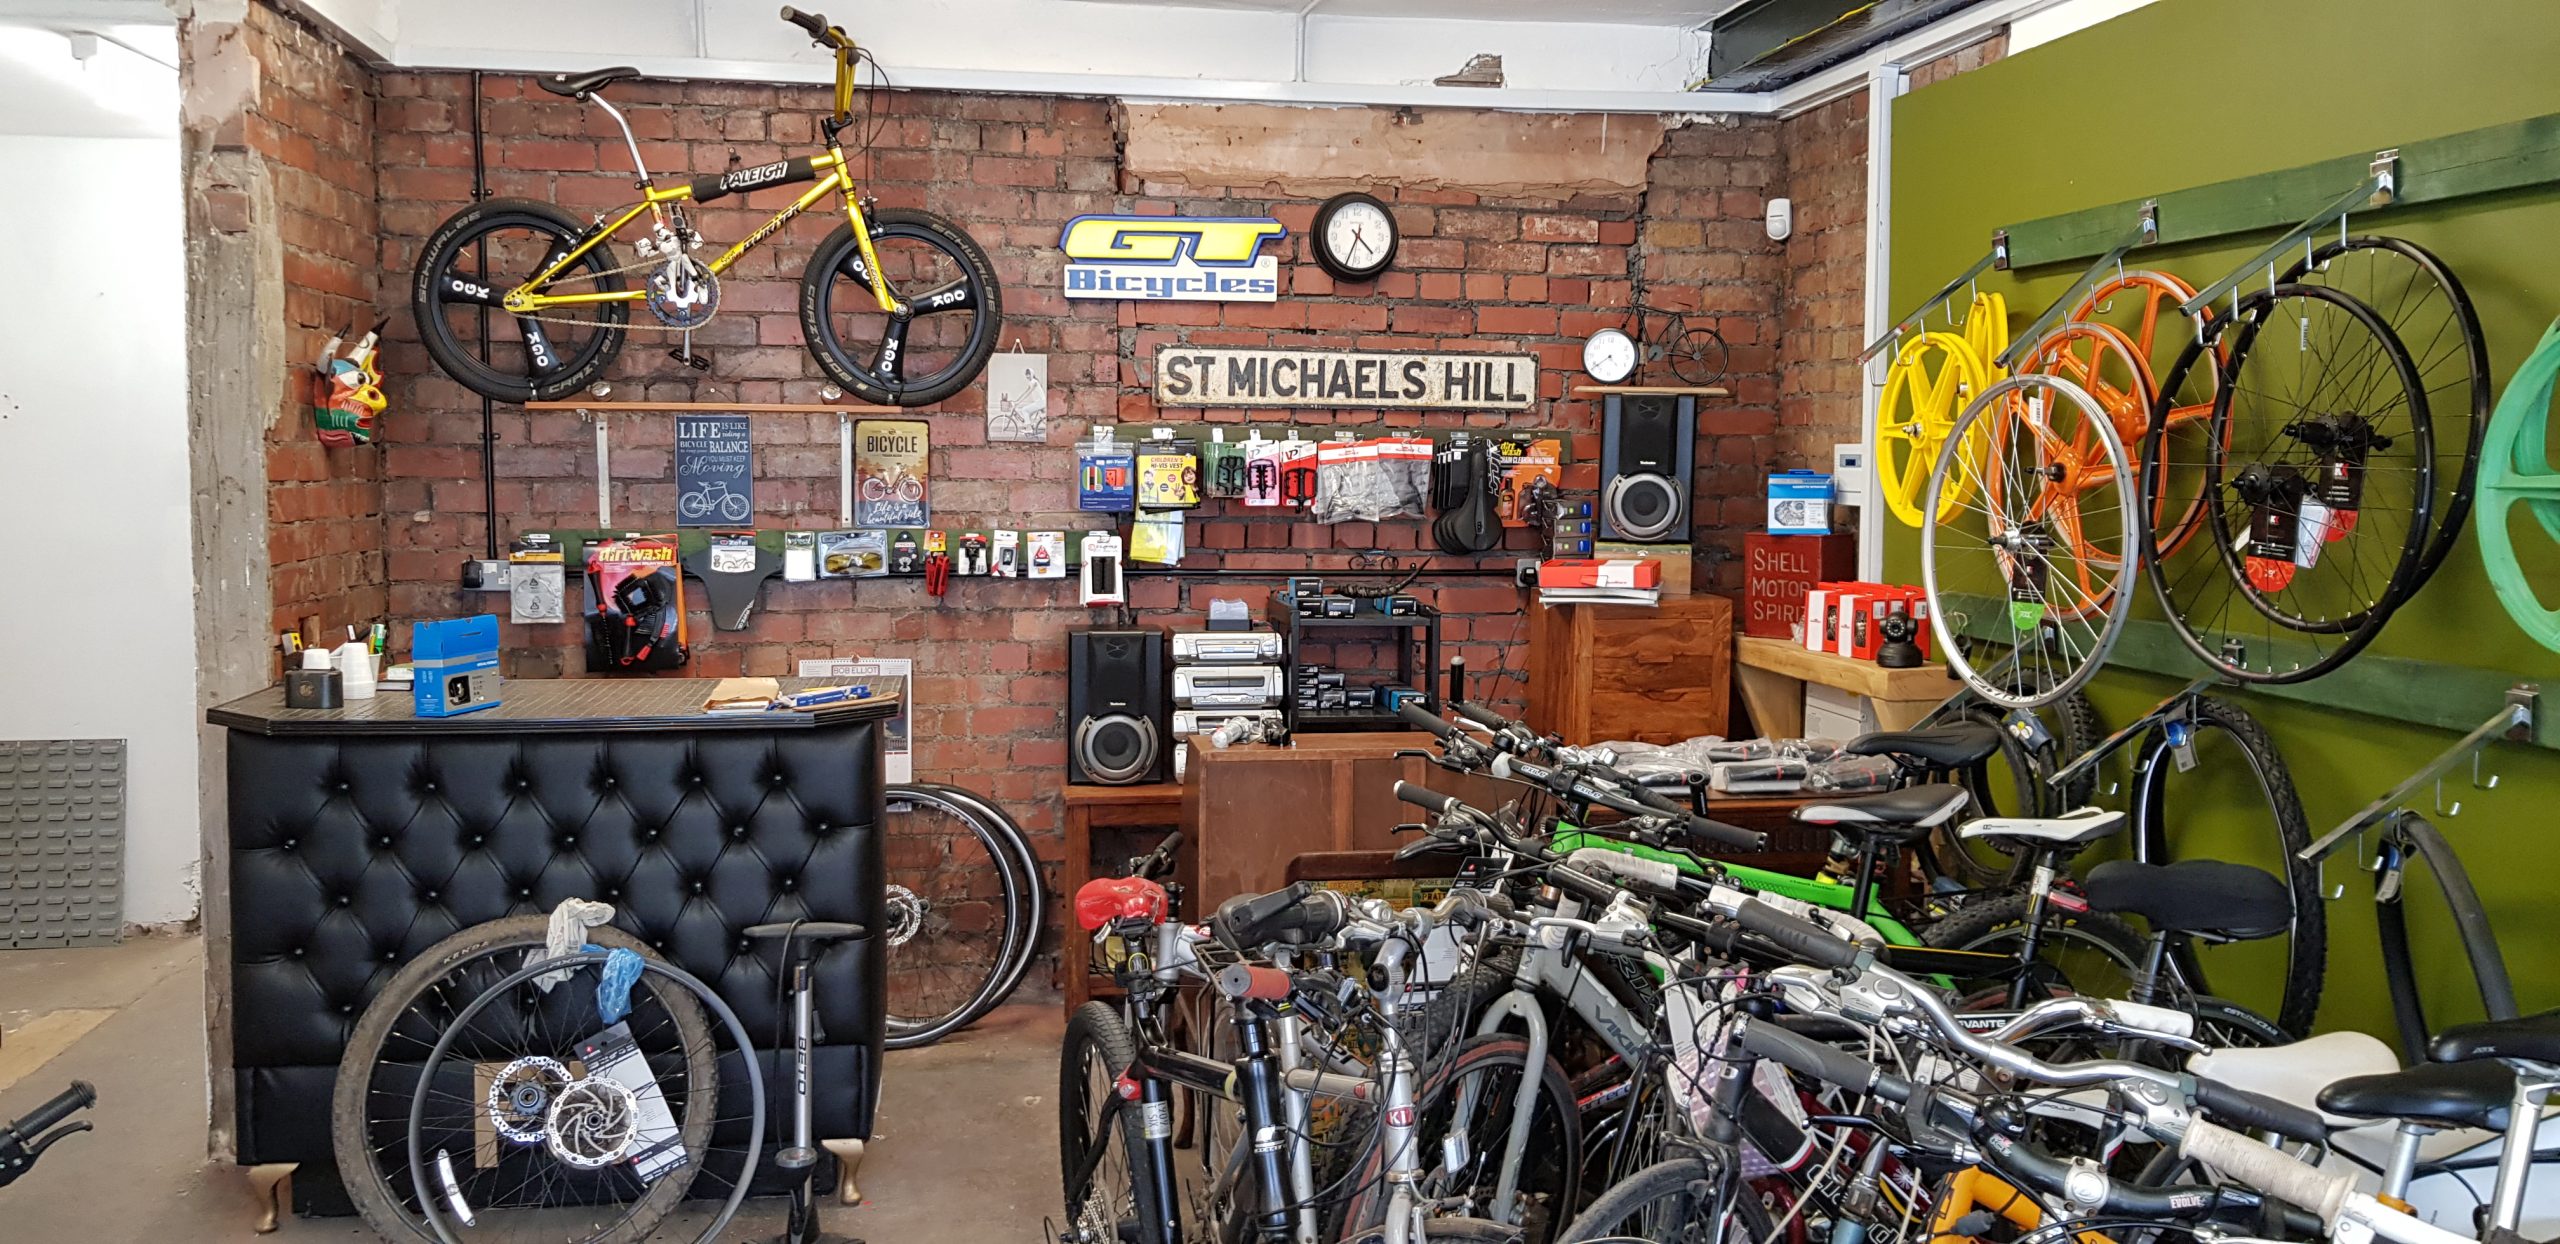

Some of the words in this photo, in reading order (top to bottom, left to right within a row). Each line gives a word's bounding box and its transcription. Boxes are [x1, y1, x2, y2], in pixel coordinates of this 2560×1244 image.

[720, 161, 788, 190] RALEIGH
[1062, 217, 1286, 265] GT
[418, 210, 482, 304] SCHWALBE
[932, 222, 996, 313] SCHWALBE
[452, 279, 490, 299] OGK
[932, 289, 966, 307] OGK
[1067, 269, 1275, 298] Bicycles
[807, 284, 824, 346] CRAZY
[527, 332, 549, 367] OGK
[881, 337, 899, 372] OGK
[548, 358, 600, 394] CRAZY
[1166, 356, 1217, 396] ST
[1227, 357, 1427, 399] MICHAELS
[1444, 362, 1528, 401] HILL
[679, 422, 721, 438] LIFE
[867, 436, 918, 453] BICYCLE
[680, 440, 708, 448] BICYCLE
[709, 441, 749, 453] BALANCE
[680, 455, 746, 479] Moving
[873, 501, 893, 514] Life
[1754, 548, 1810, 574] SHELL
[833, 666, 850, 675] BOB
[798, 1036, 807, 1096] BETO
